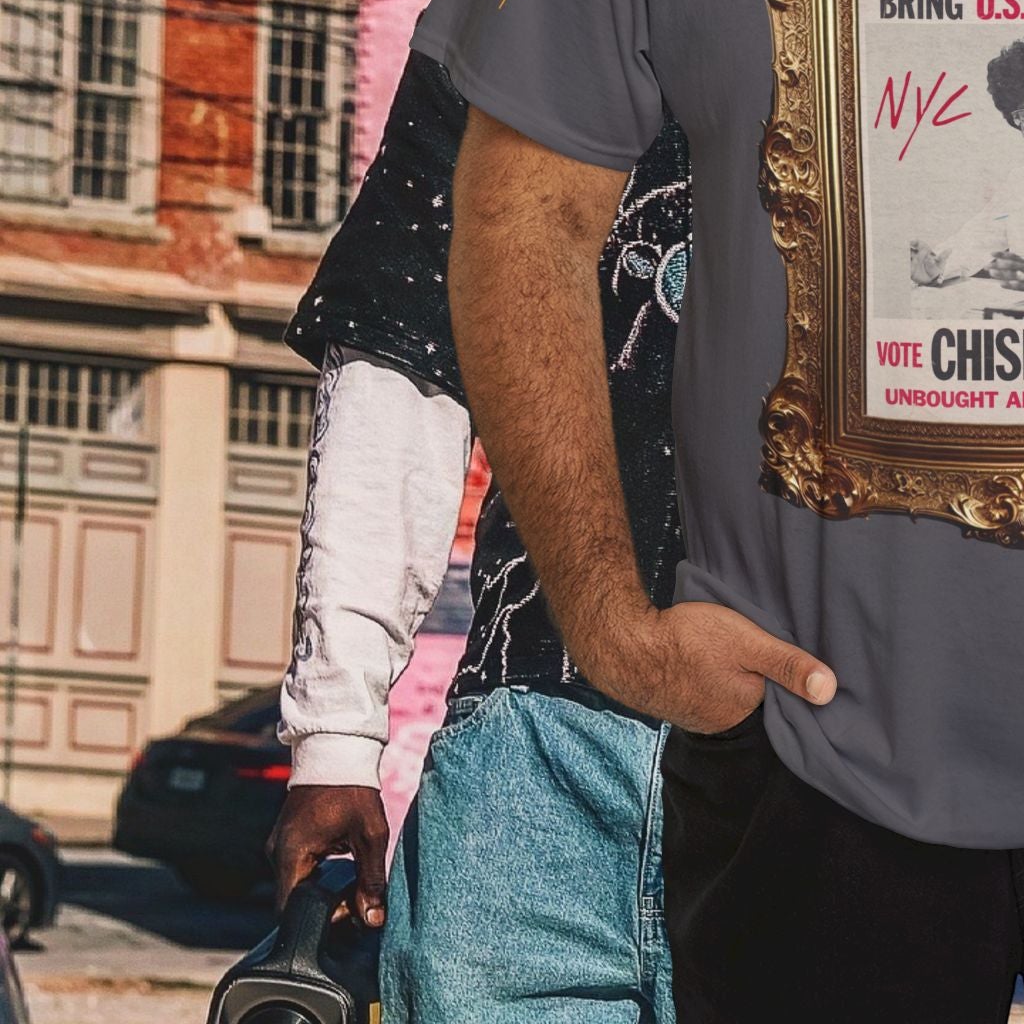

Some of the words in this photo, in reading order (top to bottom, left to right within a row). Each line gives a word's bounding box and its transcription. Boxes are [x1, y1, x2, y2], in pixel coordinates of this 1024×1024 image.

[874, 71, 972, 161] NYC
[876, 341, 923, 368] VOTE
[885, 388, 999, 409] UNBOUGHT
